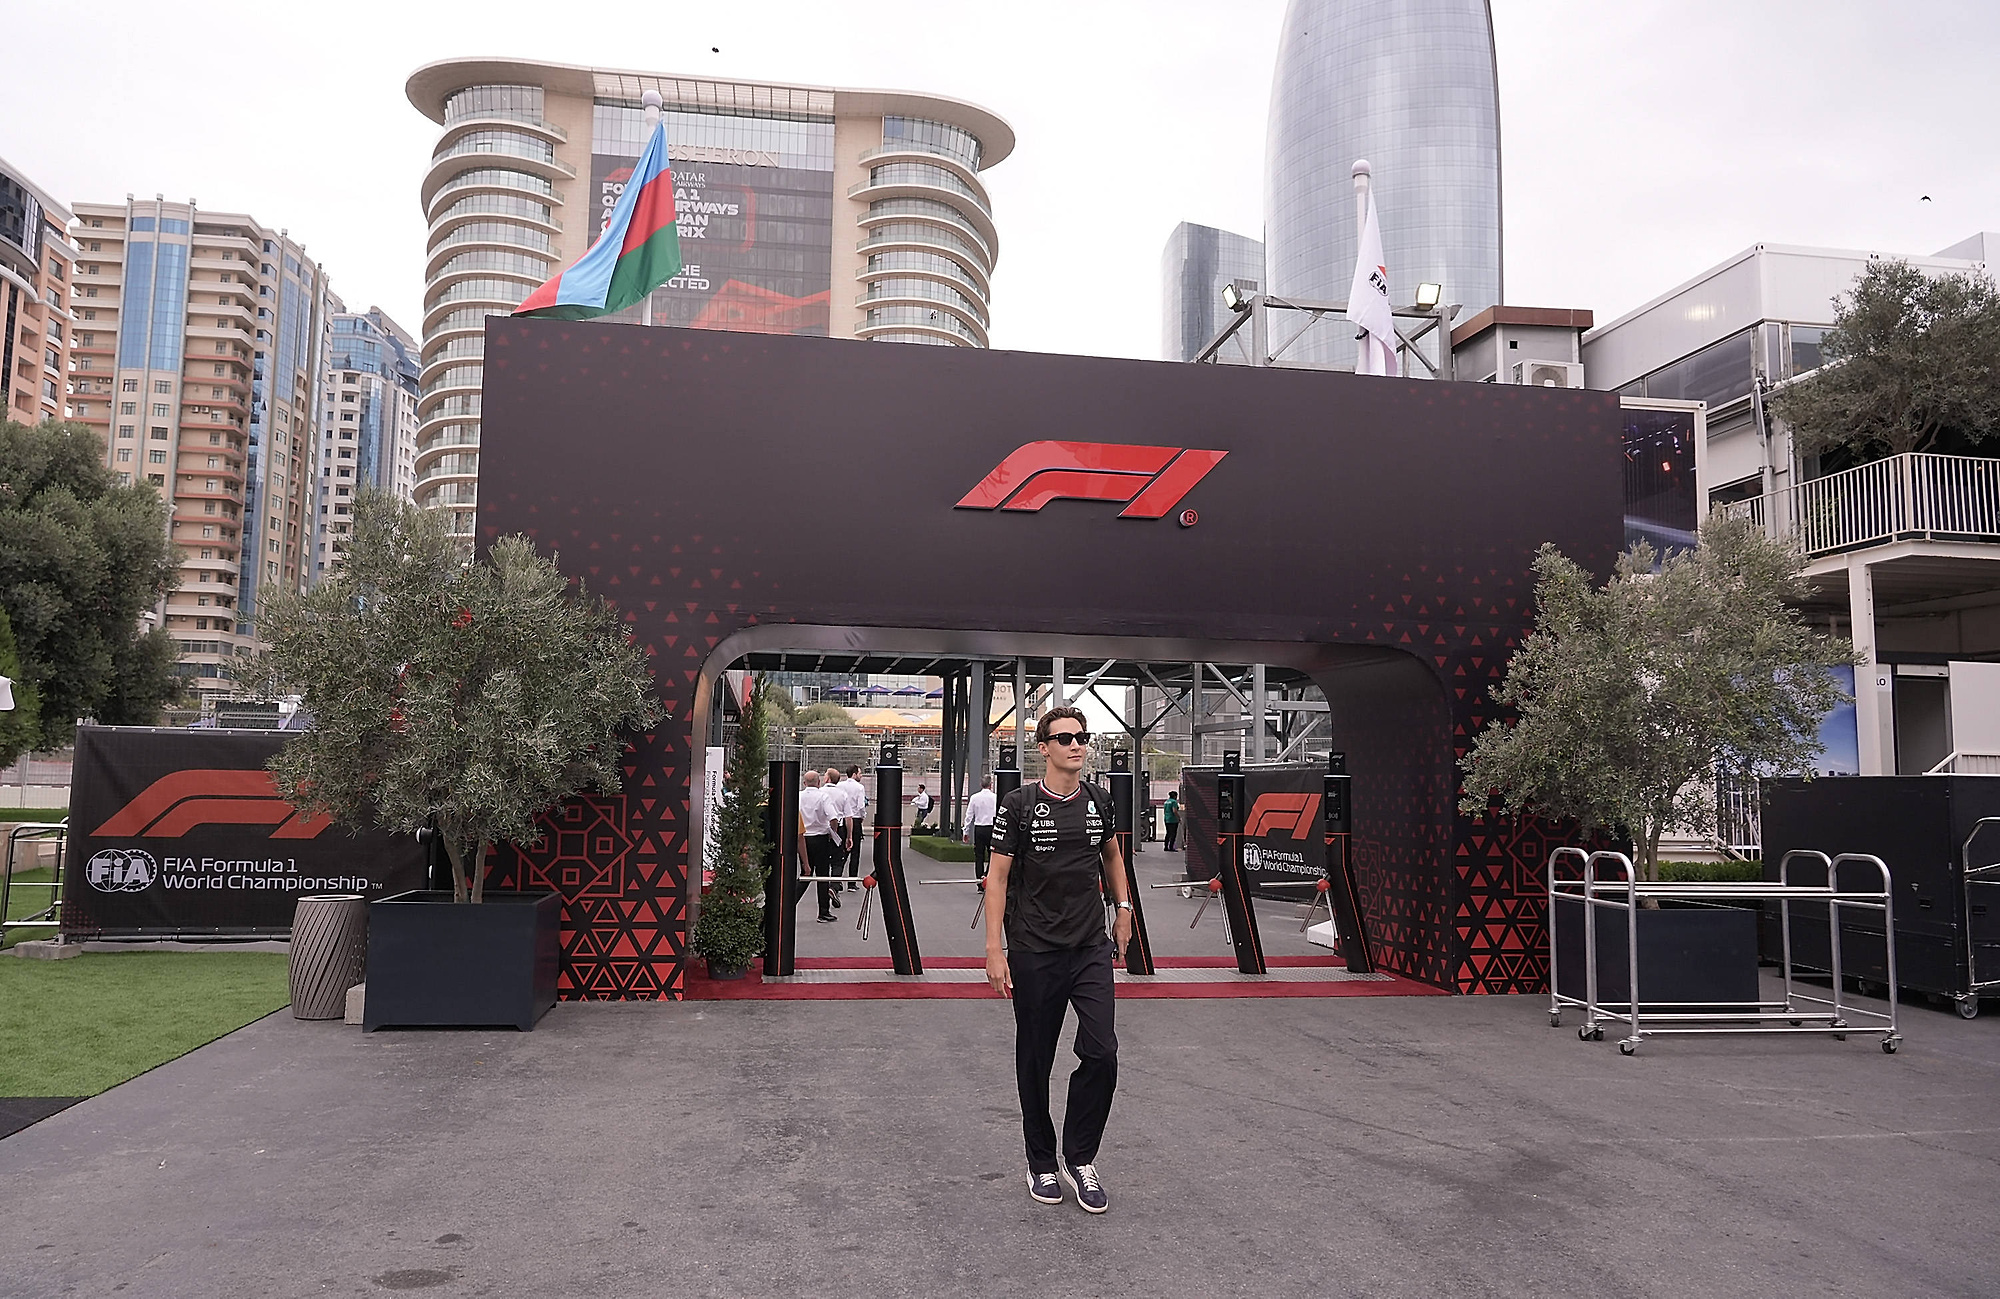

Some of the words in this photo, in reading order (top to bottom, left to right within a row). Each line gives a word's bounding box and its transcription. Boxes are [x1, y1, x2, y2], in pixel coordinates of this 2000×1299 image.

[668, 144, 780, 168] BSHERON
[671, 171, 706, 183] QATAR
[675, 200, 739, 216] IRWAYS
[677, 226, 706, 239] RIX
[678, 264, 701, 277] HE
[1274, 850, 1299, 862] Formula
[163, 857, 197, 873] FIA
[201, 857, 285, 873] Formula
[286, 858, 298, 873] 1
[1262, 860, 1283, 872] World
[162, 874, 223, 889] World
[227, 875, 369, 892] Championship
